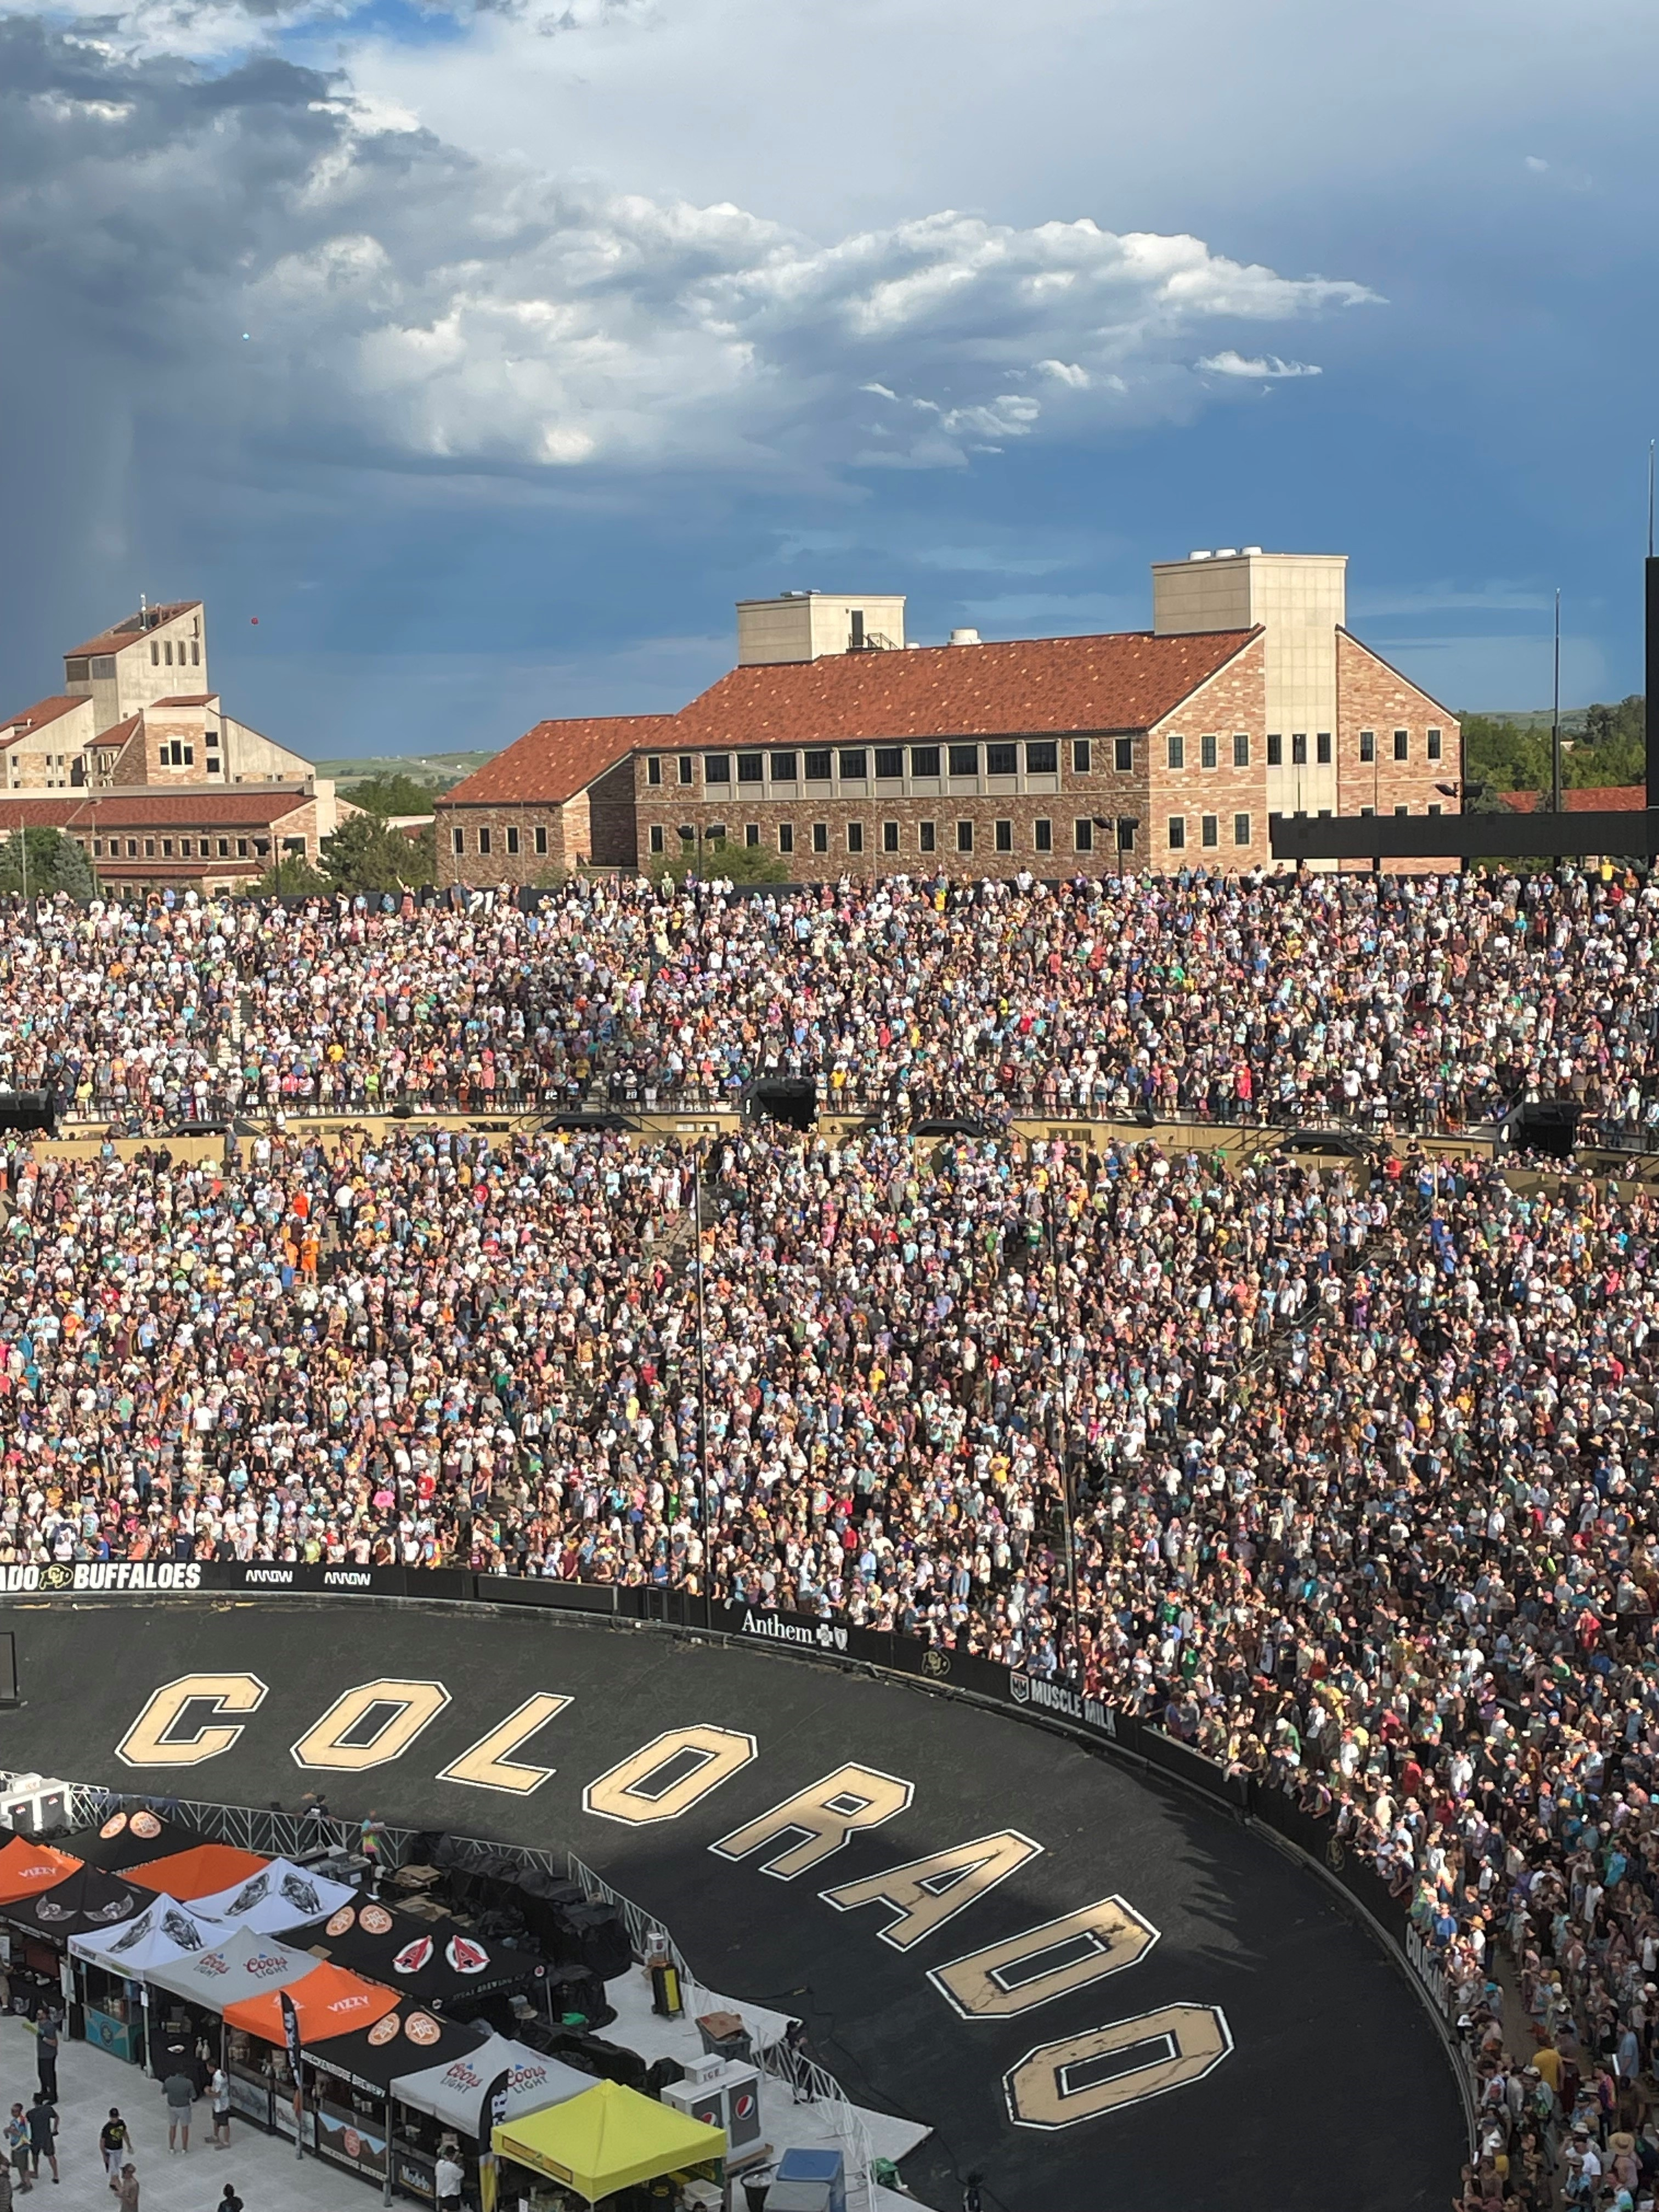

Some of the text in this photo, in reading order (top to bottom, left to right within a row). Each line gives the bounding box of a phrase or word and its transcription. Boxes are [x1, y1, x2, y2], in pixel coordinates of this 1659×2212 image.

[73, 1563, 201, 1589] BUFFALOES
[246, 1570, 293, 1583] ARROW
[324, 1572, 371, 1585] ARROW
[741, 1609, 816, 1644] Anthem
[1031, 1678, 1082, 1718] MUSCLE
[1084, 1697, 1117, 1738] MILK
[18, 1866, 57, 1878] VIZZY
[243, 1956, 288, 1973] Coors
[255, 1964, 289, 1978] LIGHT
[328, 1995, 369, 2012] VIZZY
[703, 2068, 720, 2080] ICE
[440, 2076, 472, 2094] LIGHT
[513, 2076, 549, 2094] LIGHT
